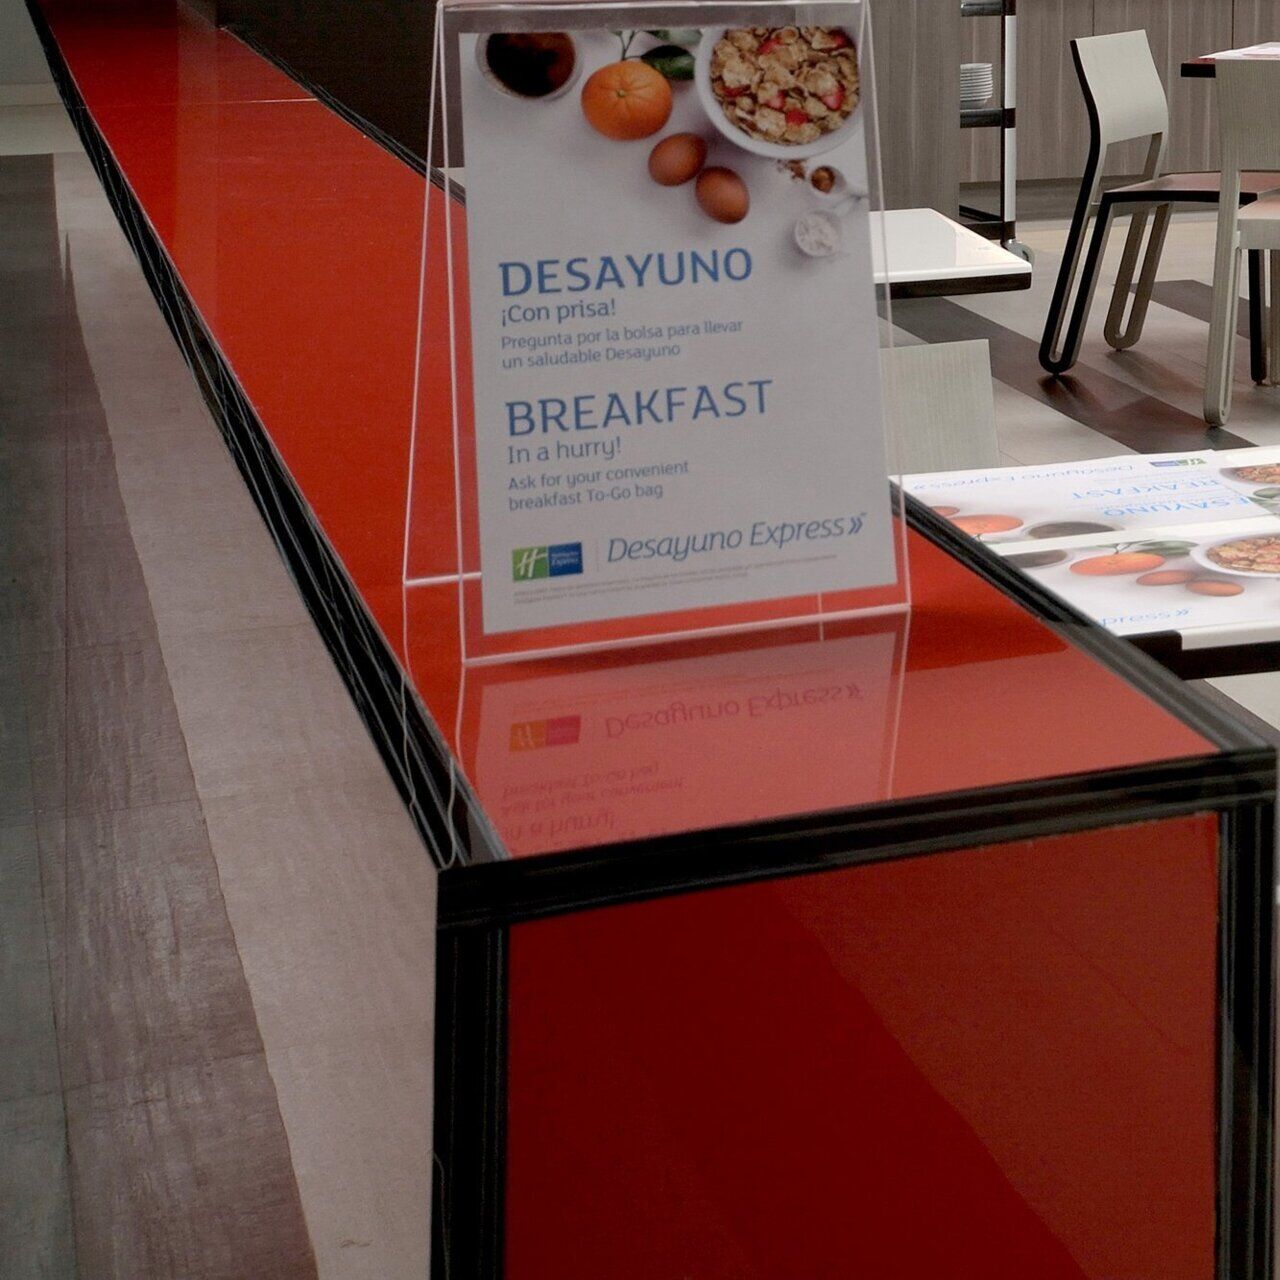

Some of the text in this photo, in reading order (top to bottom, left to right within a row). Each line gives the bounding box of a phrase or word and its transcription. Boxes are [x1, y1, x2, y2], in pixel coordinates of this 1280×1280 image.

[498, 247, 753, 297] DESAYUNO
[501, 297, 617, 327] ¡Con prisa!
[501, 319, 744, 351] Pregunta por la bolsa para llevar
[501, 343, 681, 370] un saludable Desayuno
[504, 379, 773, 438] BREAKFAST
[507, 436, 622, 465] In a hurry!
[508, 461, 690, 491] Ask for your convenient
[508, 482, 664, 512] breakfast To-Go bag
[606, 516, 846, 563] Desayuno Express
